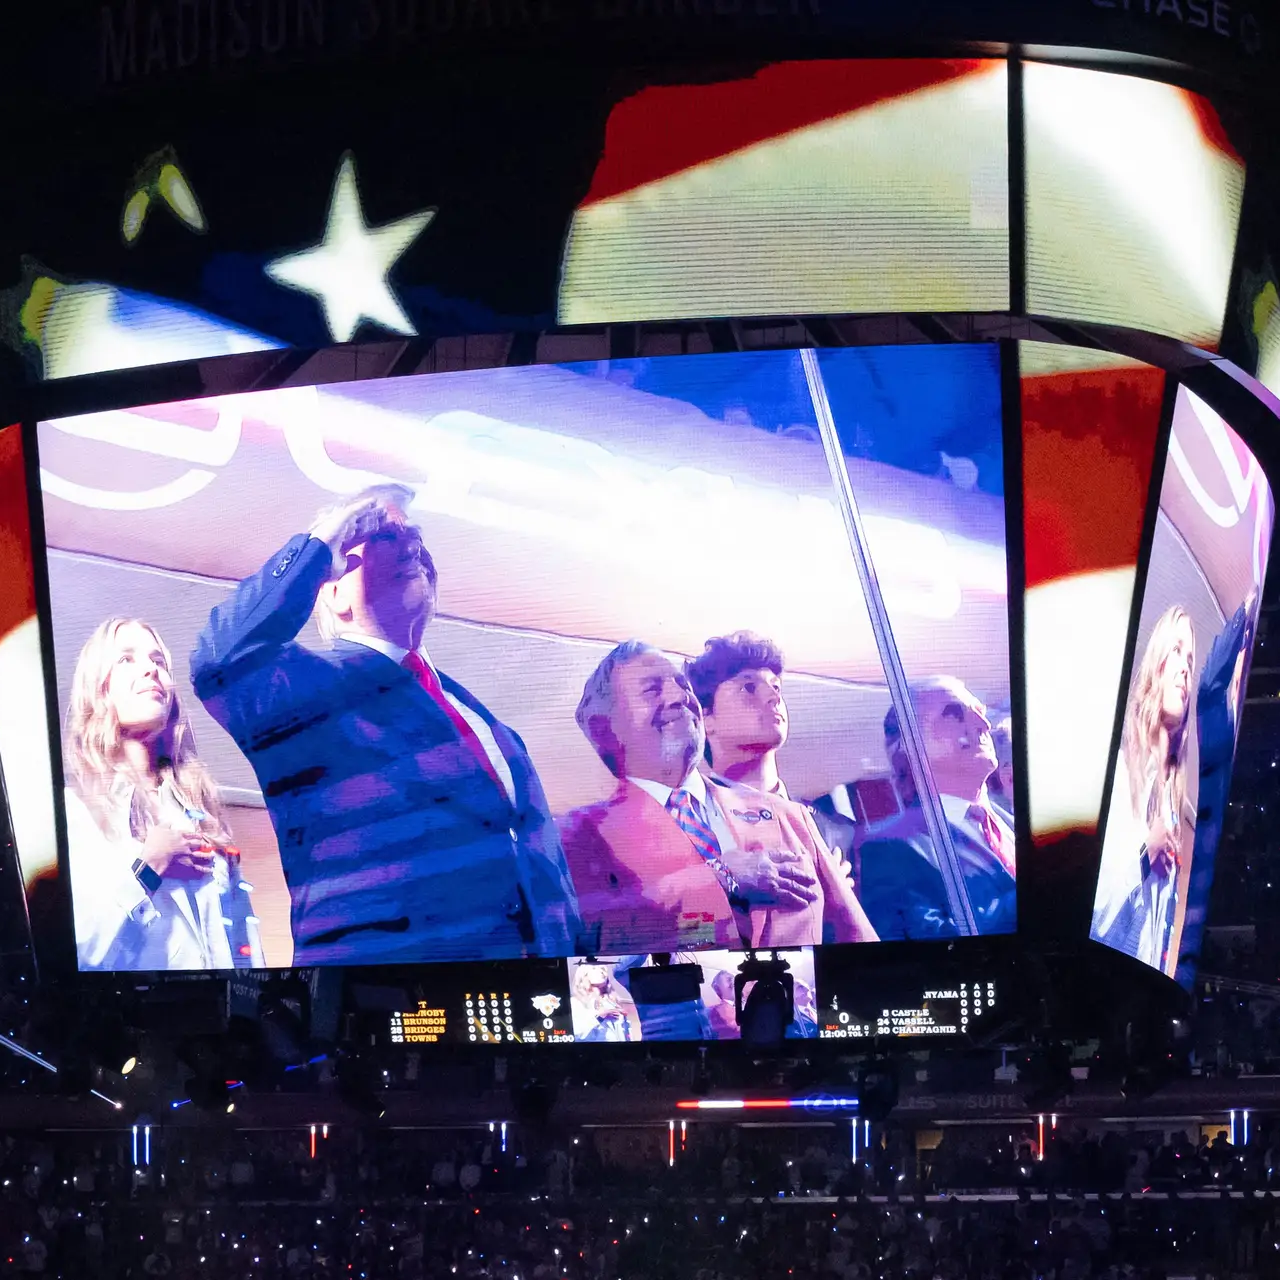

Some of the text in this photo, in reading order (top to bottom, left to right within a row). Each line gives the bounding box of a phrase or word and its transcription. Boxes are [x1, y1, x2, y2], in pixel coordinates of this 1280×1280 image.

[492, 1008, 499, 1016] 0
[839, 1012, 849, 1023] 0
[543, 1018, 553, 1029] 0
[404, 1026, 445, 1034] BRIDGES
[820, 1030, 847, 1038] 12:00
